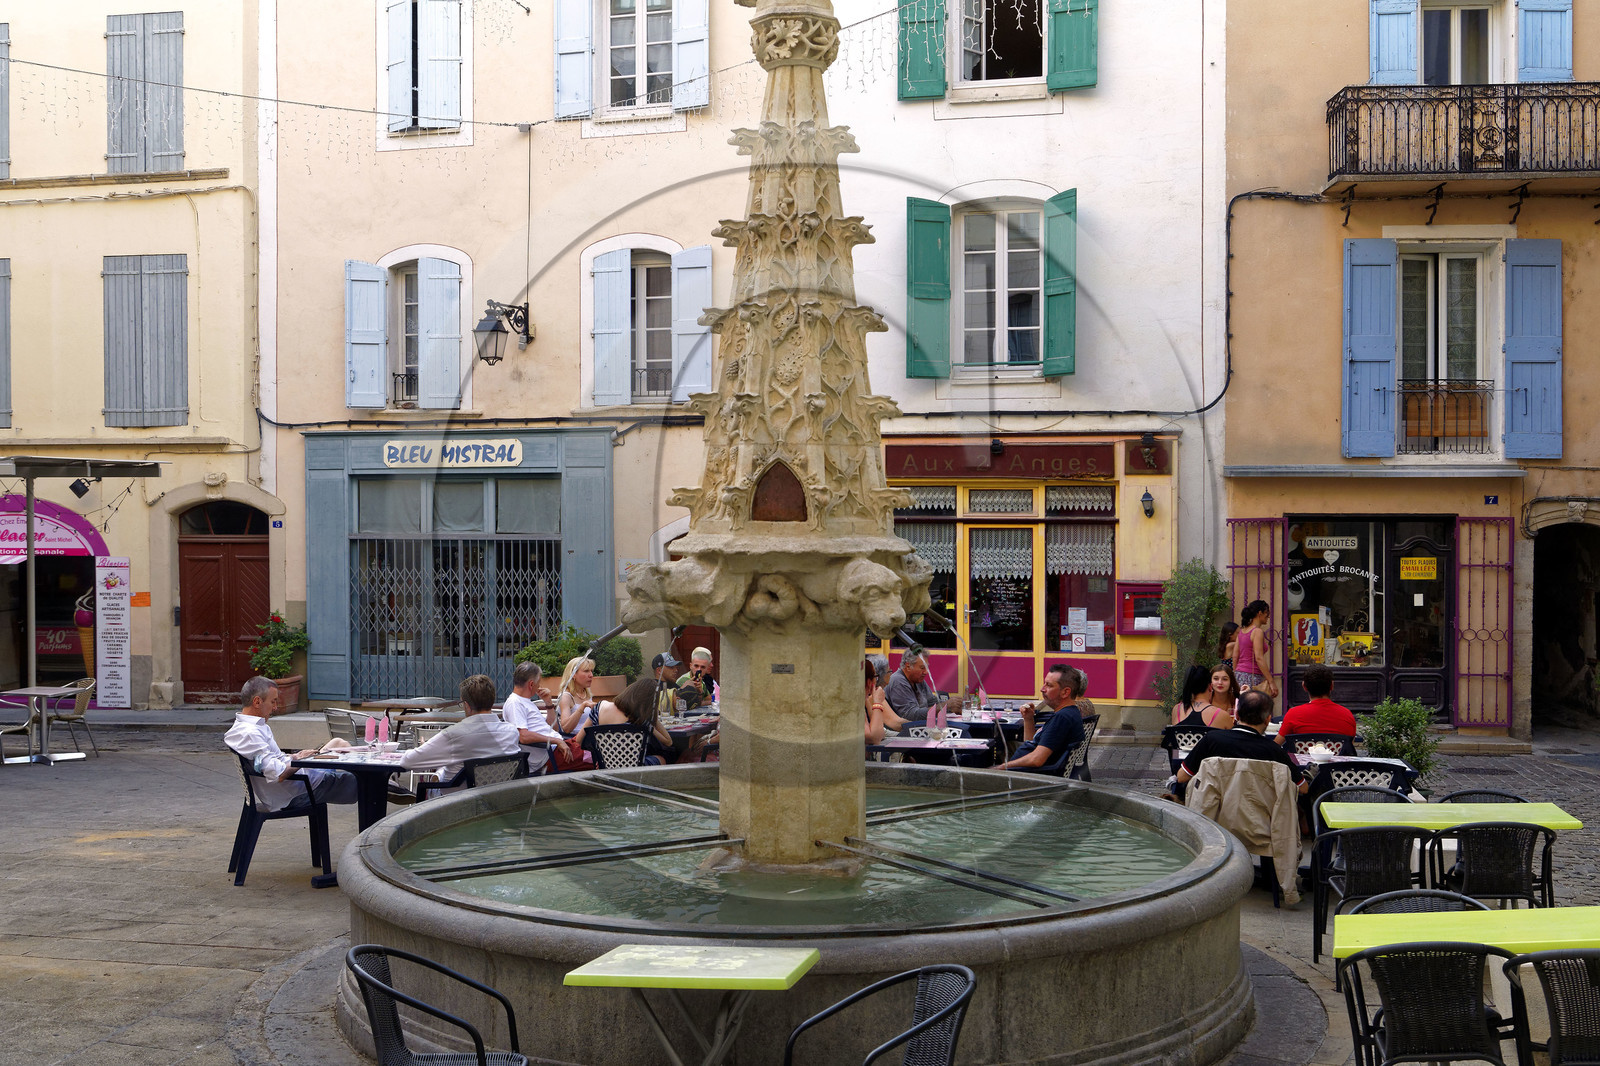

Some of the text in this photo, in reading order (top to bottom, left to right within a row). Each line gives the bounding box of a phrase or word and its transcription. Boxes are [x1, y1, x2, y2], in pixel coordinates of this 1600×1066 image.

[387, 444, 517, 464] BLEU MISTRAL
[903, 454, 1098, 473] Aux 2 Anges
[1307, 538, 1356, 547] ANTIQUITÉS
[1291, 564, 1380, 584] ANTIQUITÉS BROCANTE
[46, 630, 66, 643] 40
[39, 642, 72, 651] Parfums
[1294, 646, 1324, 656] Astral
